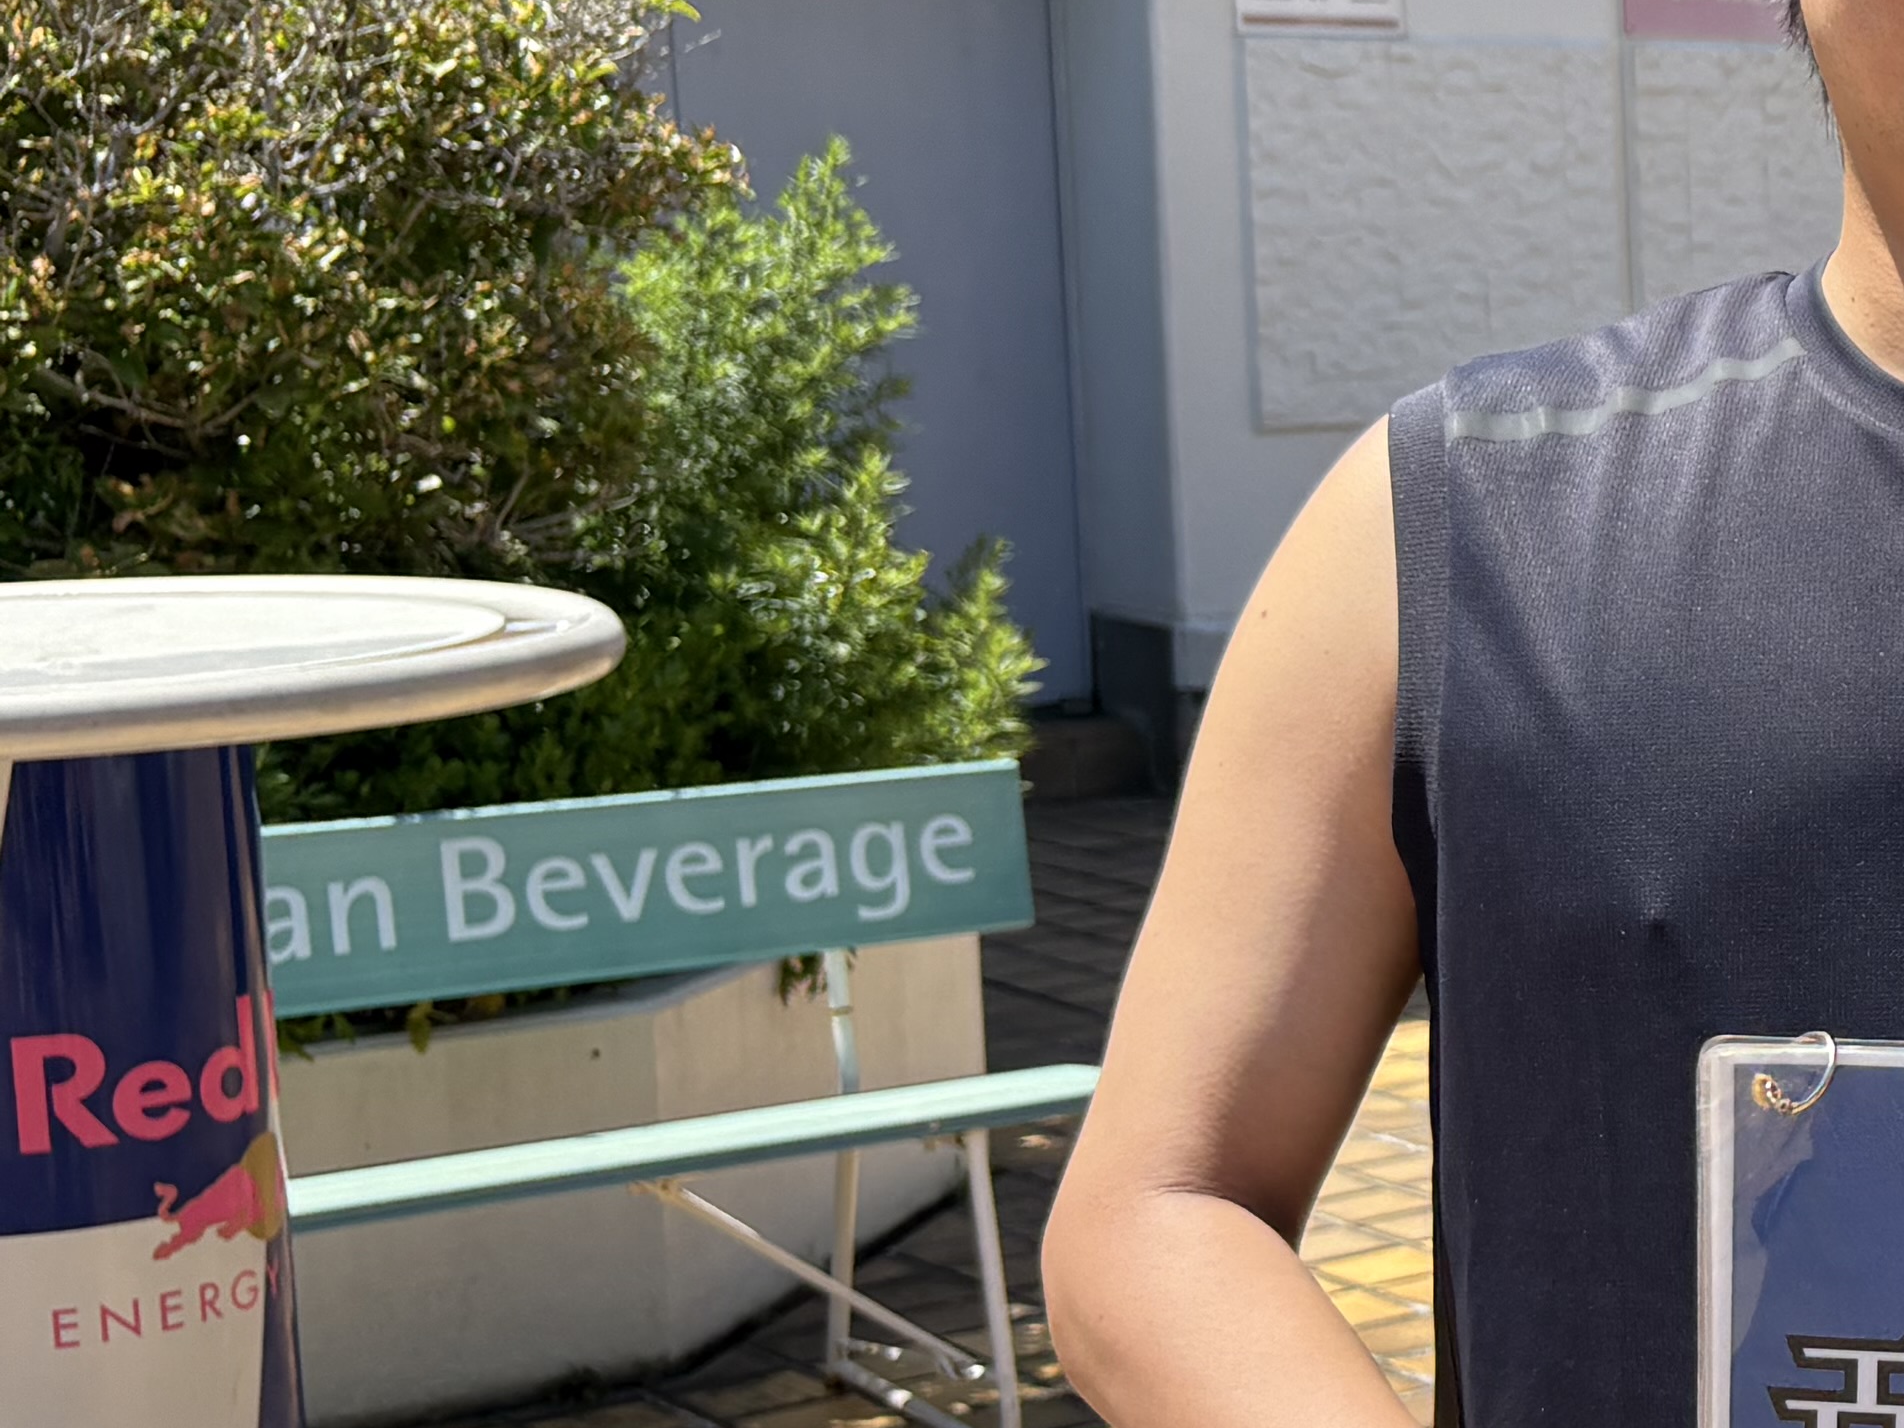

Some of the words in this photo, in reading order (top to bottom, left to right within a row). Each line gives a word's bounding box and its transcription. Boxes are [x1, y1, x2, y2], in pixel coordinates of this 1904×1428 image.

[439, 813, 975, 943] Beverage
[10, 993, 260, 1154] Red
[52, 1260, 279, 1349] ENERGY
